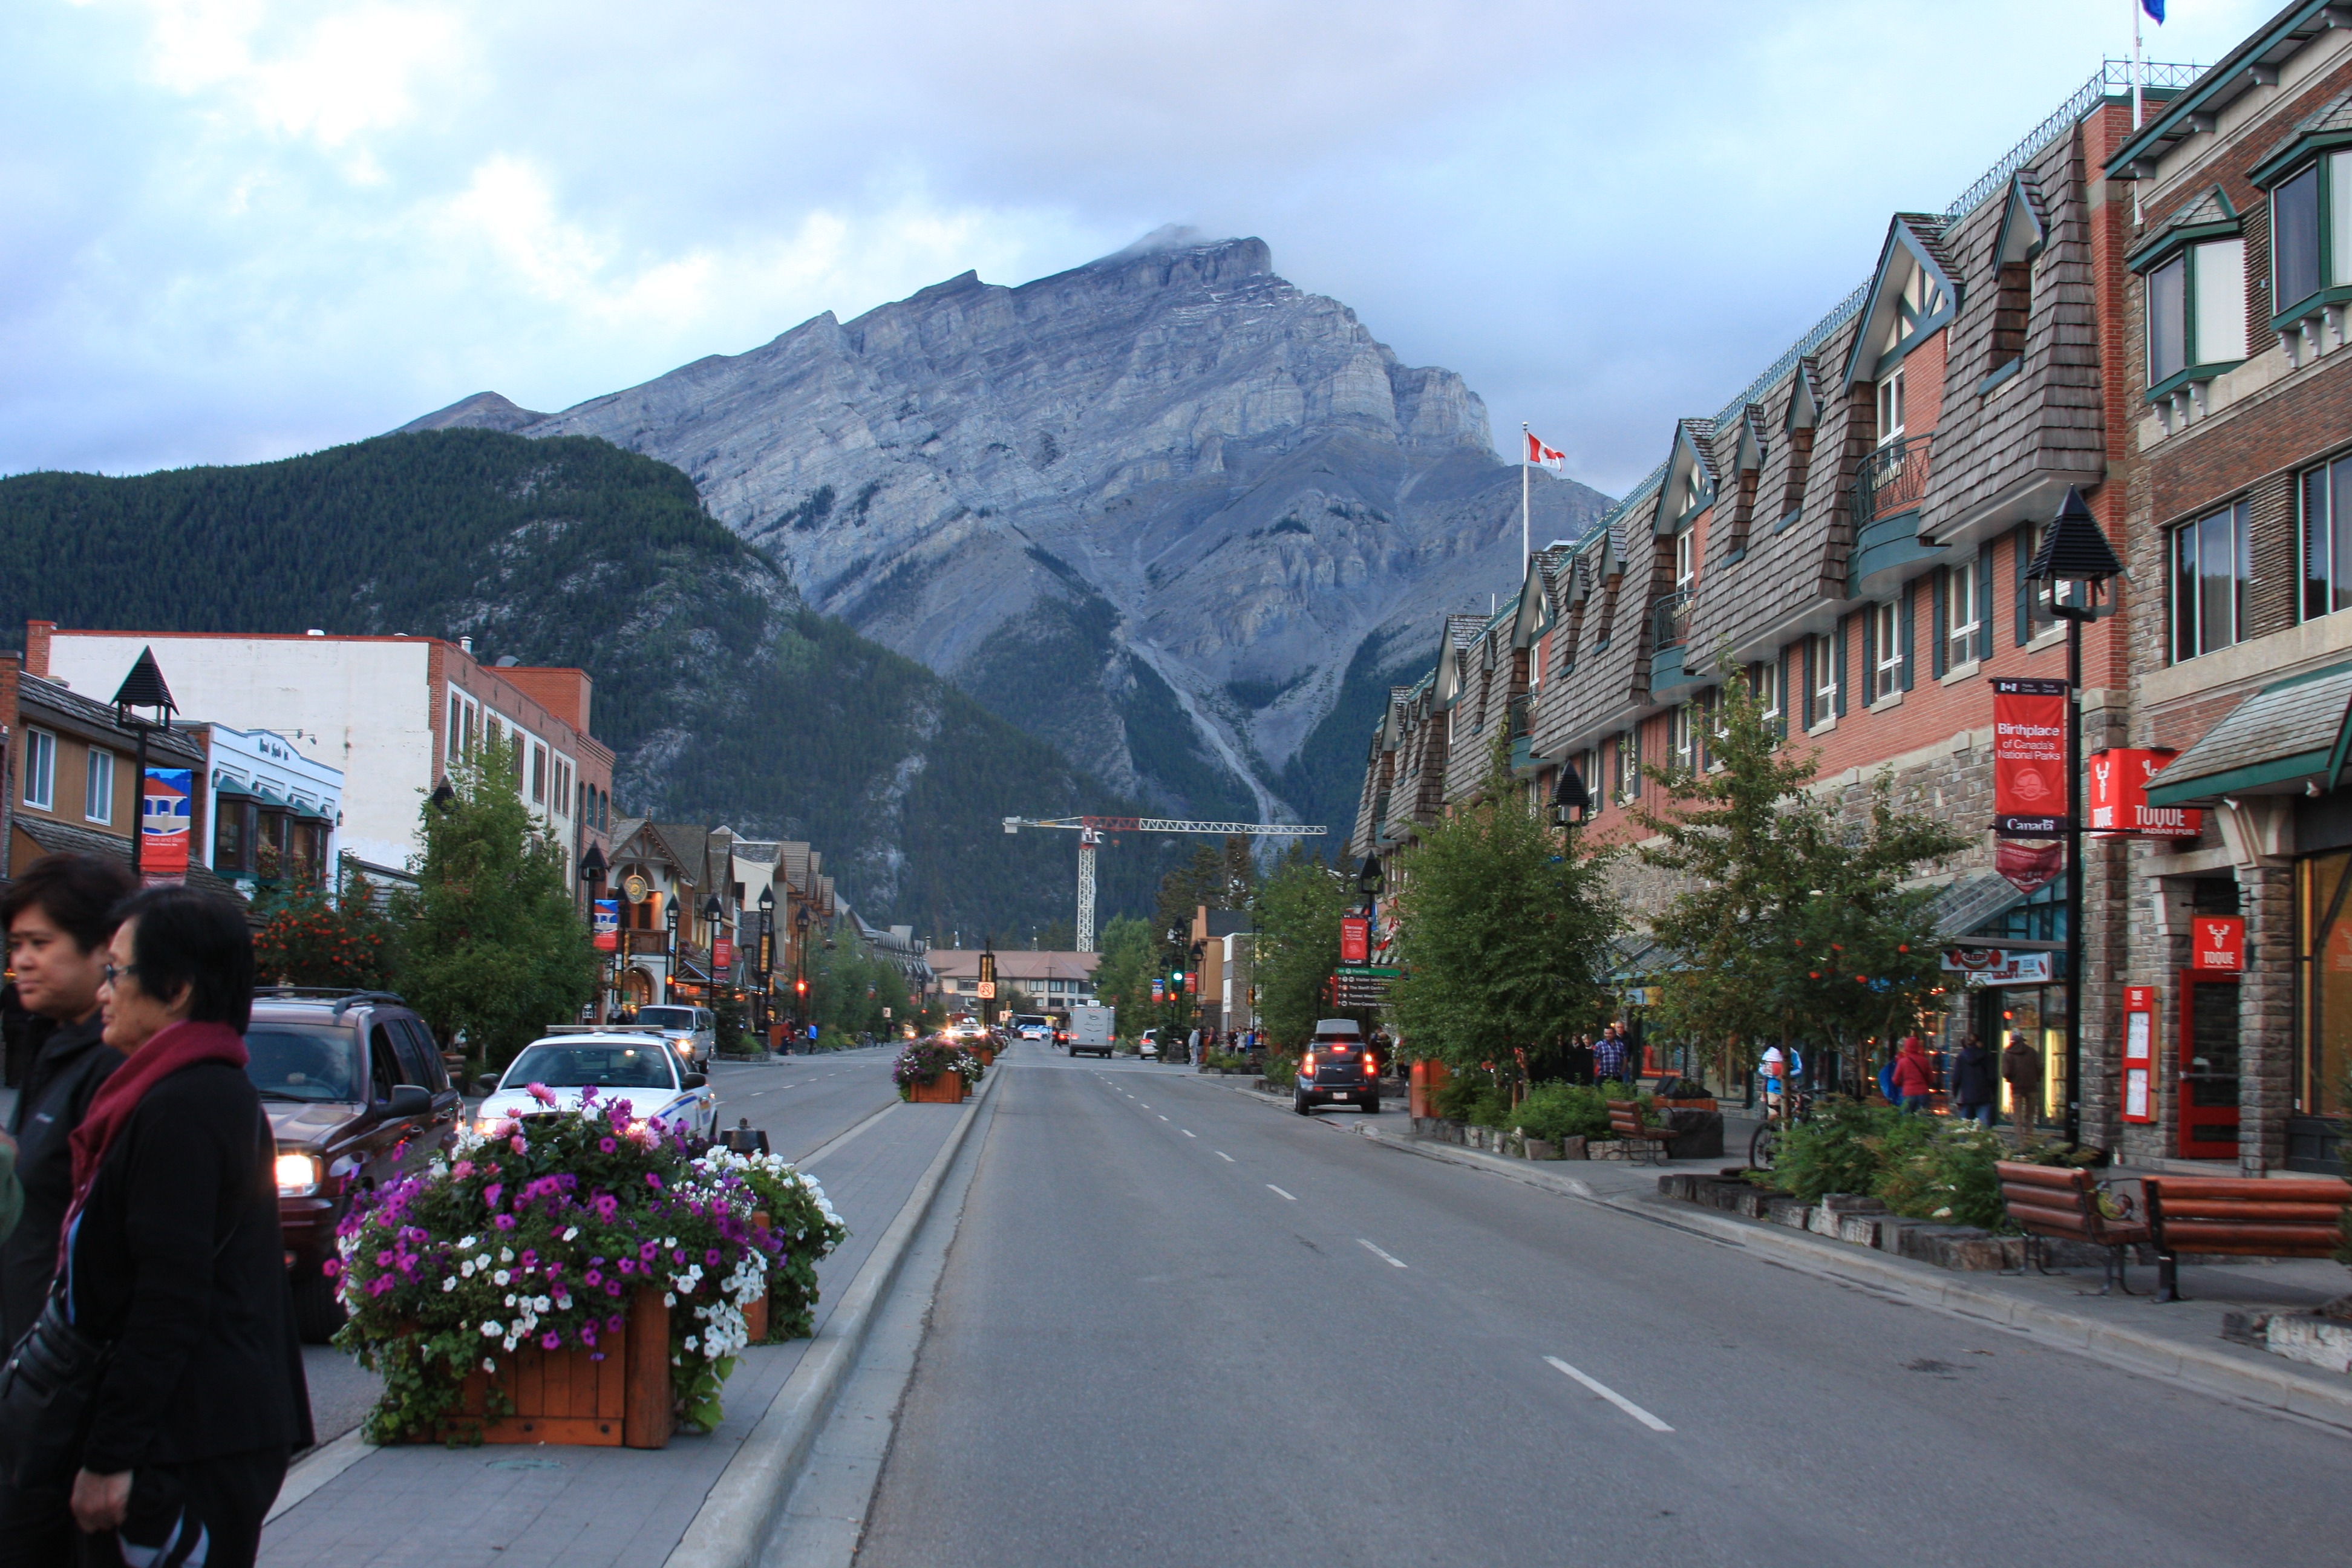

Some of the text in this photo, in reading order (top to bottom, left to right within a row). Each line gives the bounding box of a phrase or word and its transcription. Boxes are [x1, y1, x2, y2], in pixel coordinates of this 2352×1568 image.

[1998, 723, 2060, 738] Birthplace
[2002, 739, 2055, 750] of Canada's
[1998, 750, 2061, 760] National Parks
[2007, 818, 2054, 831] Canada
